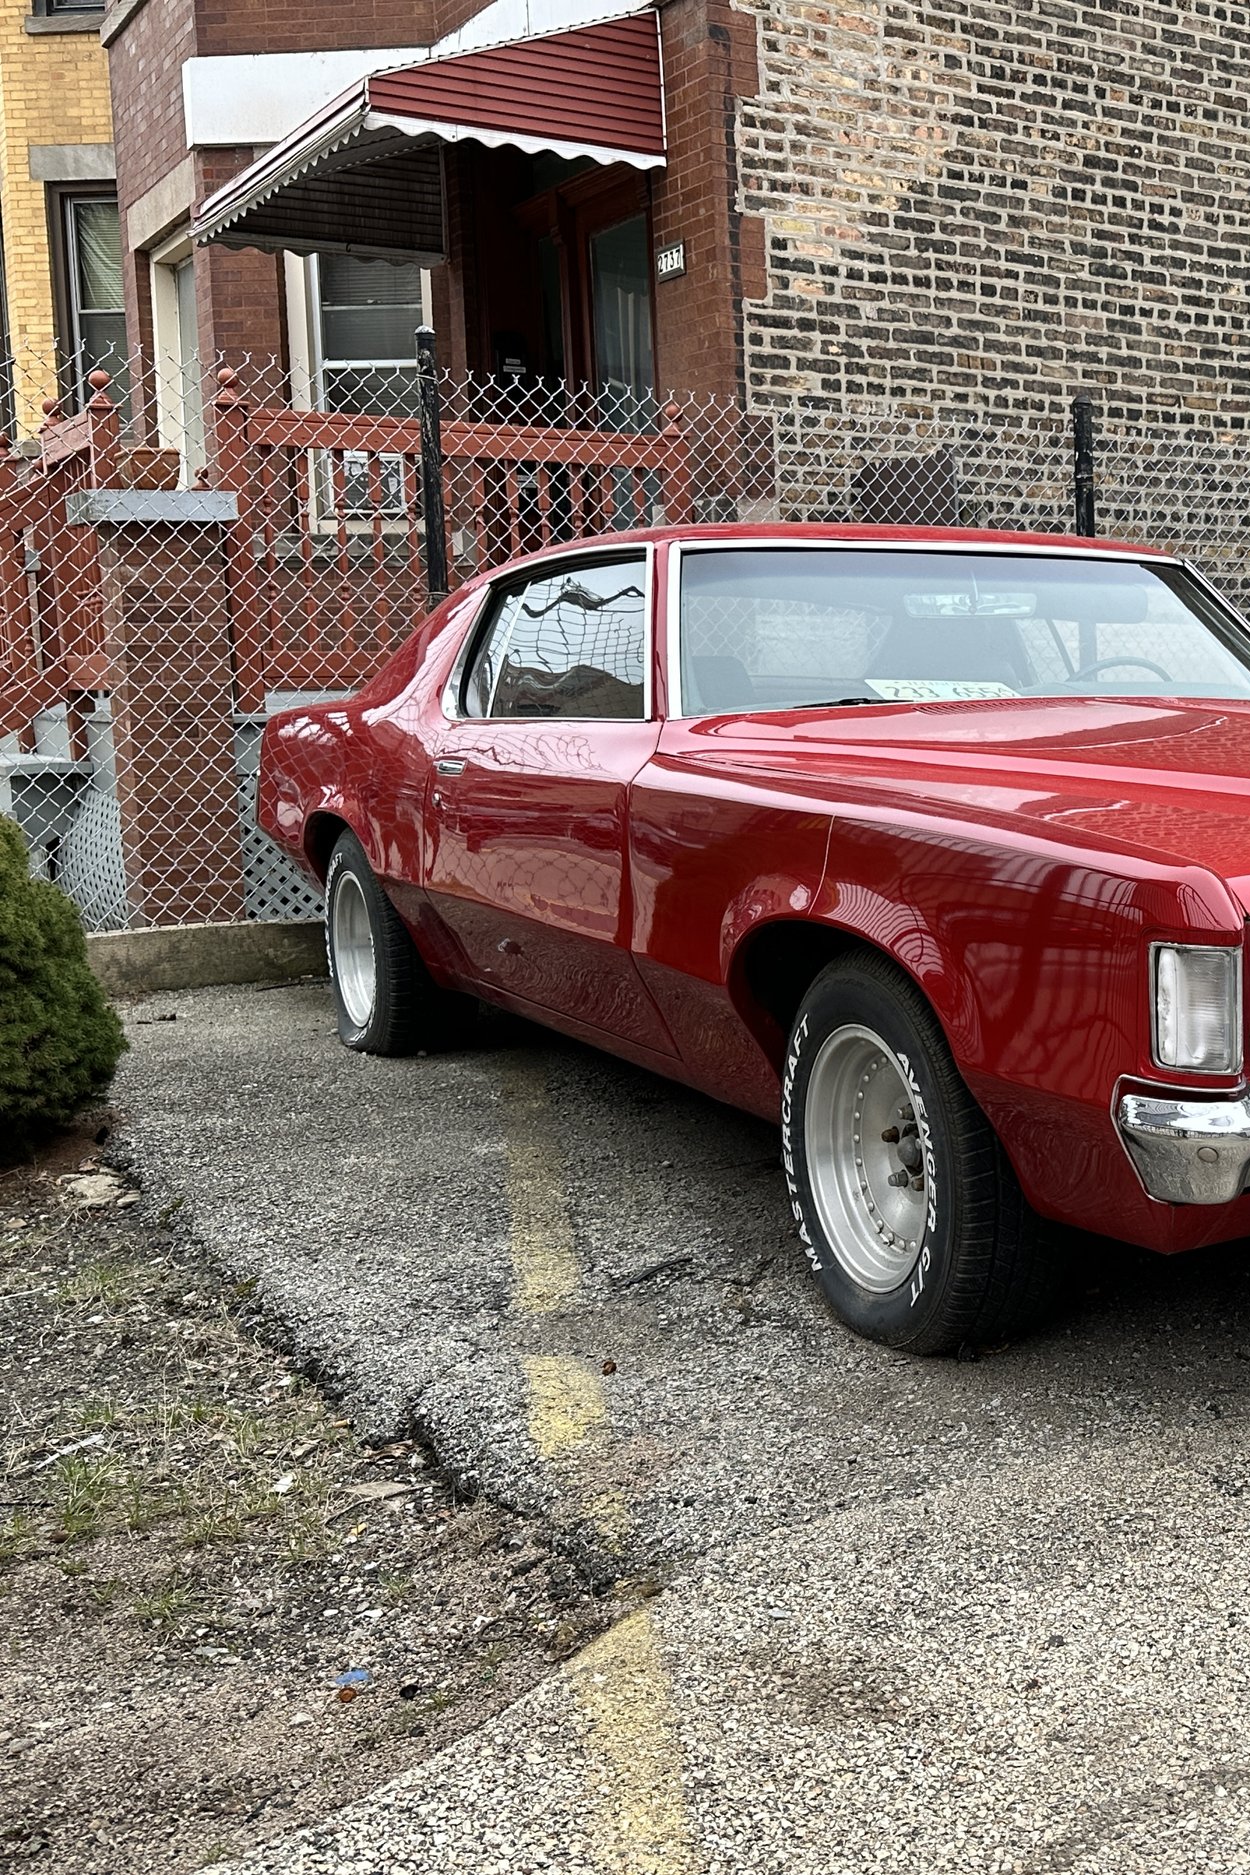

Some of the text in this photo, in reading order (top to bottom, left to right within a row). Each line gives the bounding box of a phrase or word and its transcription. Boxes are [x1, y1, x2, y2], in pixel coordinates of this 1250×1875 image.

[658, 248, 680, 272] 2737
[885, 687, 941, 699] 233
[782, 1013, 823, 1272] MASTERCRAFT
[897, 1052, 937, 1308] AVENGER G/T
